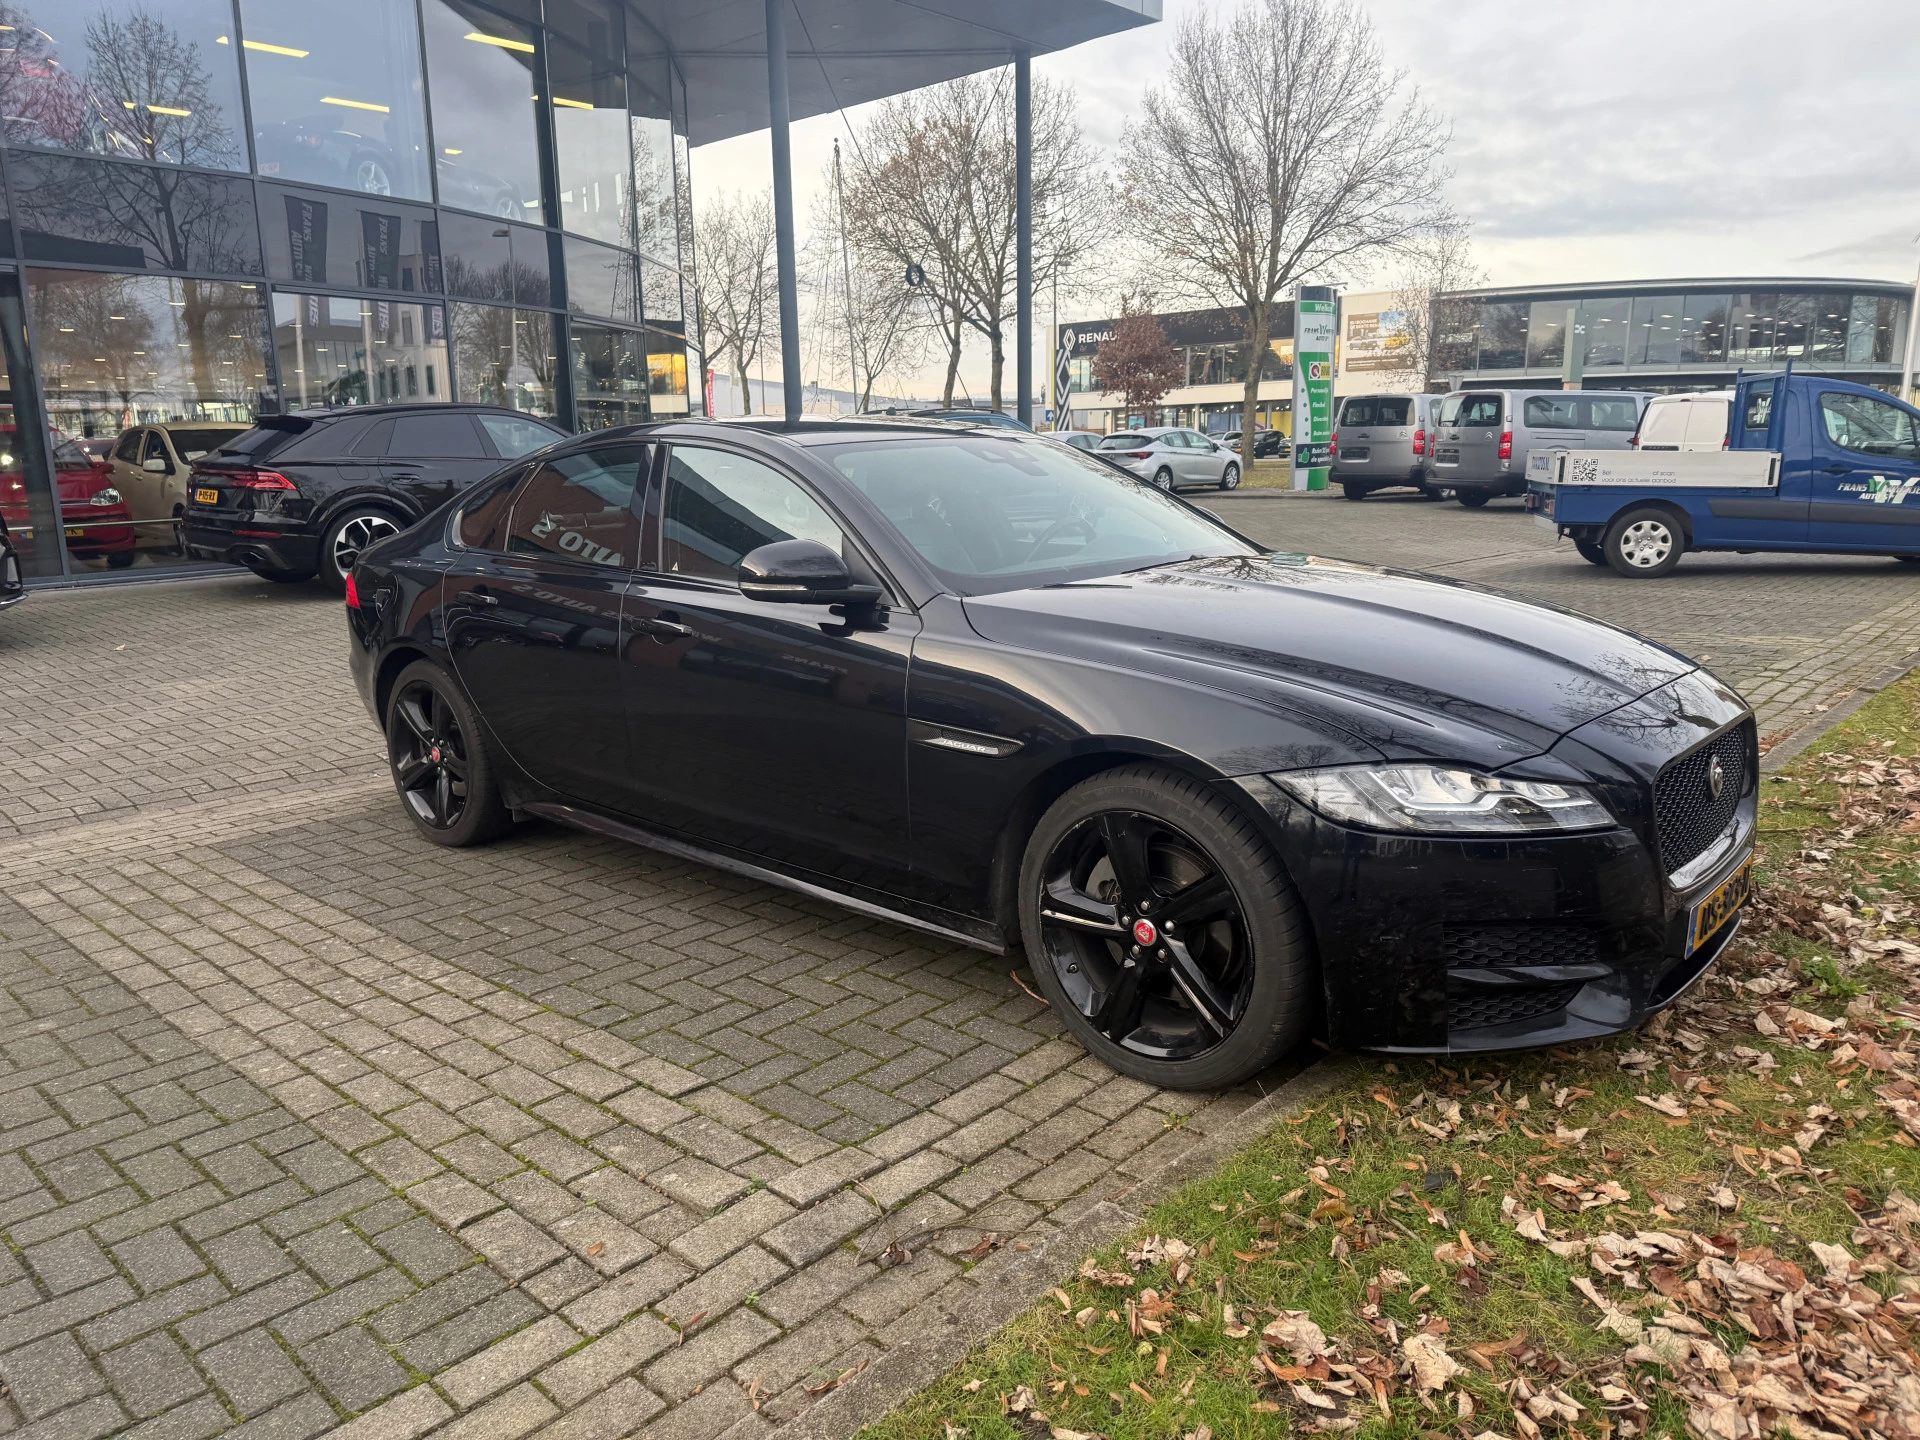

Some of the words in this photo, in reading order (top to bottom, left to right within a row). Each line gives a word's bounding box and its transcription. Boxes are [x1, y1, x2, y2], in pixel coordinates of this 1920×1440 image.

[1078, 331, 1118, 344] RENAU
[1837, 483, 1869, 492] FRANS
[939, 739, 986, 753] JAGUAR
